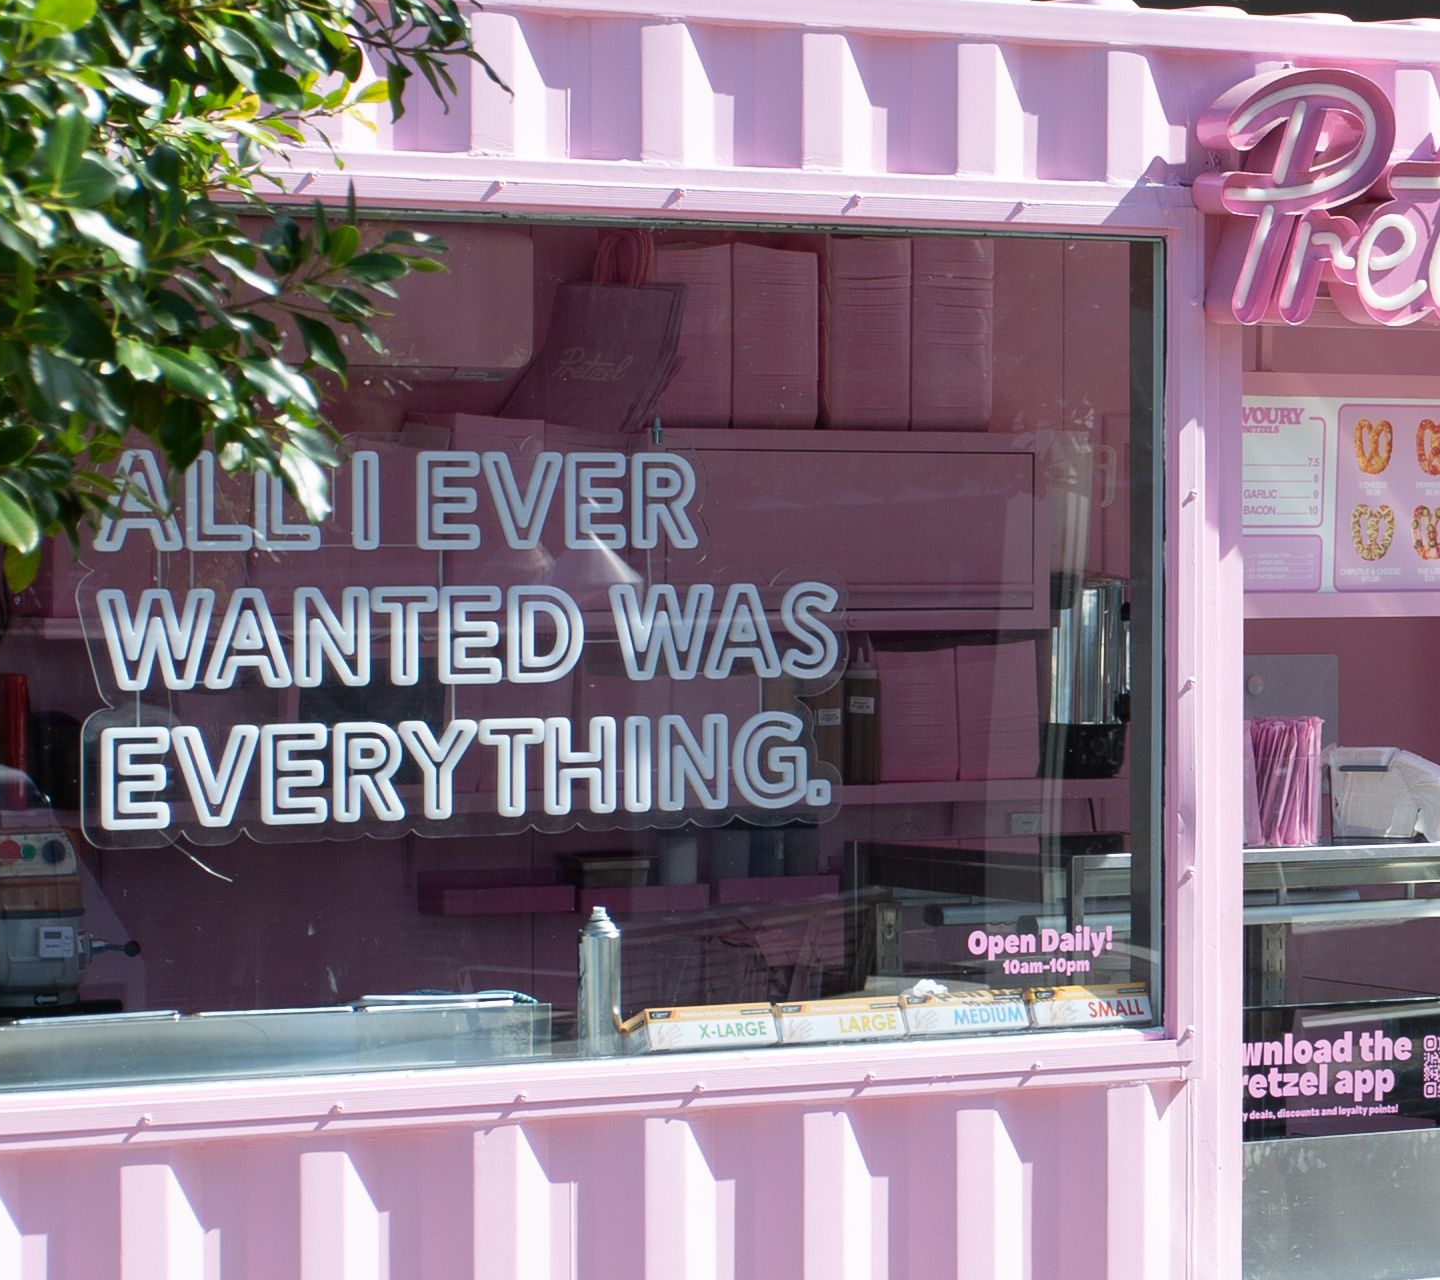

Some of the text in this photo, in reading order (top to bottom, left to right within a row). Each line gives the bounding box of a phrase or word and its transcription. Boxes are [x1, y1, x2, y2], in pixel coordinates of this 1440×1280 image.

[1242, 407, 1305, 425] VOURY
[1306, 457, 1320, 467] 7.5
[1313, 474, 1319, 483] 8
[92, 449, 699, 552] ALL I EVER
[1243, 489, 1319, 499] GARLIC 9
[1243, 505, 1319, 515] BACON 10
[95, 579, 841, 691] WANTED WAS
[99, 710, 832, 831] EVERYTHING.
[967, 924, 1113, 961] Open Daily!
[1002, 957, 1091, 977] 10am-10pm
[954, 1006, 1026, 1025] MEDIUM
[1088, 999, 1146, 1018] SMALL
[698, 1021, 767, 1039] X-LARGE
[838, 1014, 897, 1033] LARGE
[1242, 1030, 1412, 1066] wnload the
[1242, 1063, 1395, 1102] retzel app
[1249, 1109, 1276, 1120] deals,
[1276, 1107, 1320, 1119] discounts
[1321, 1106, 1337, 1117] and
[1338, 1105, 1368, 1118] loyalty
[1368, 1103, 1399, 1116] points!
